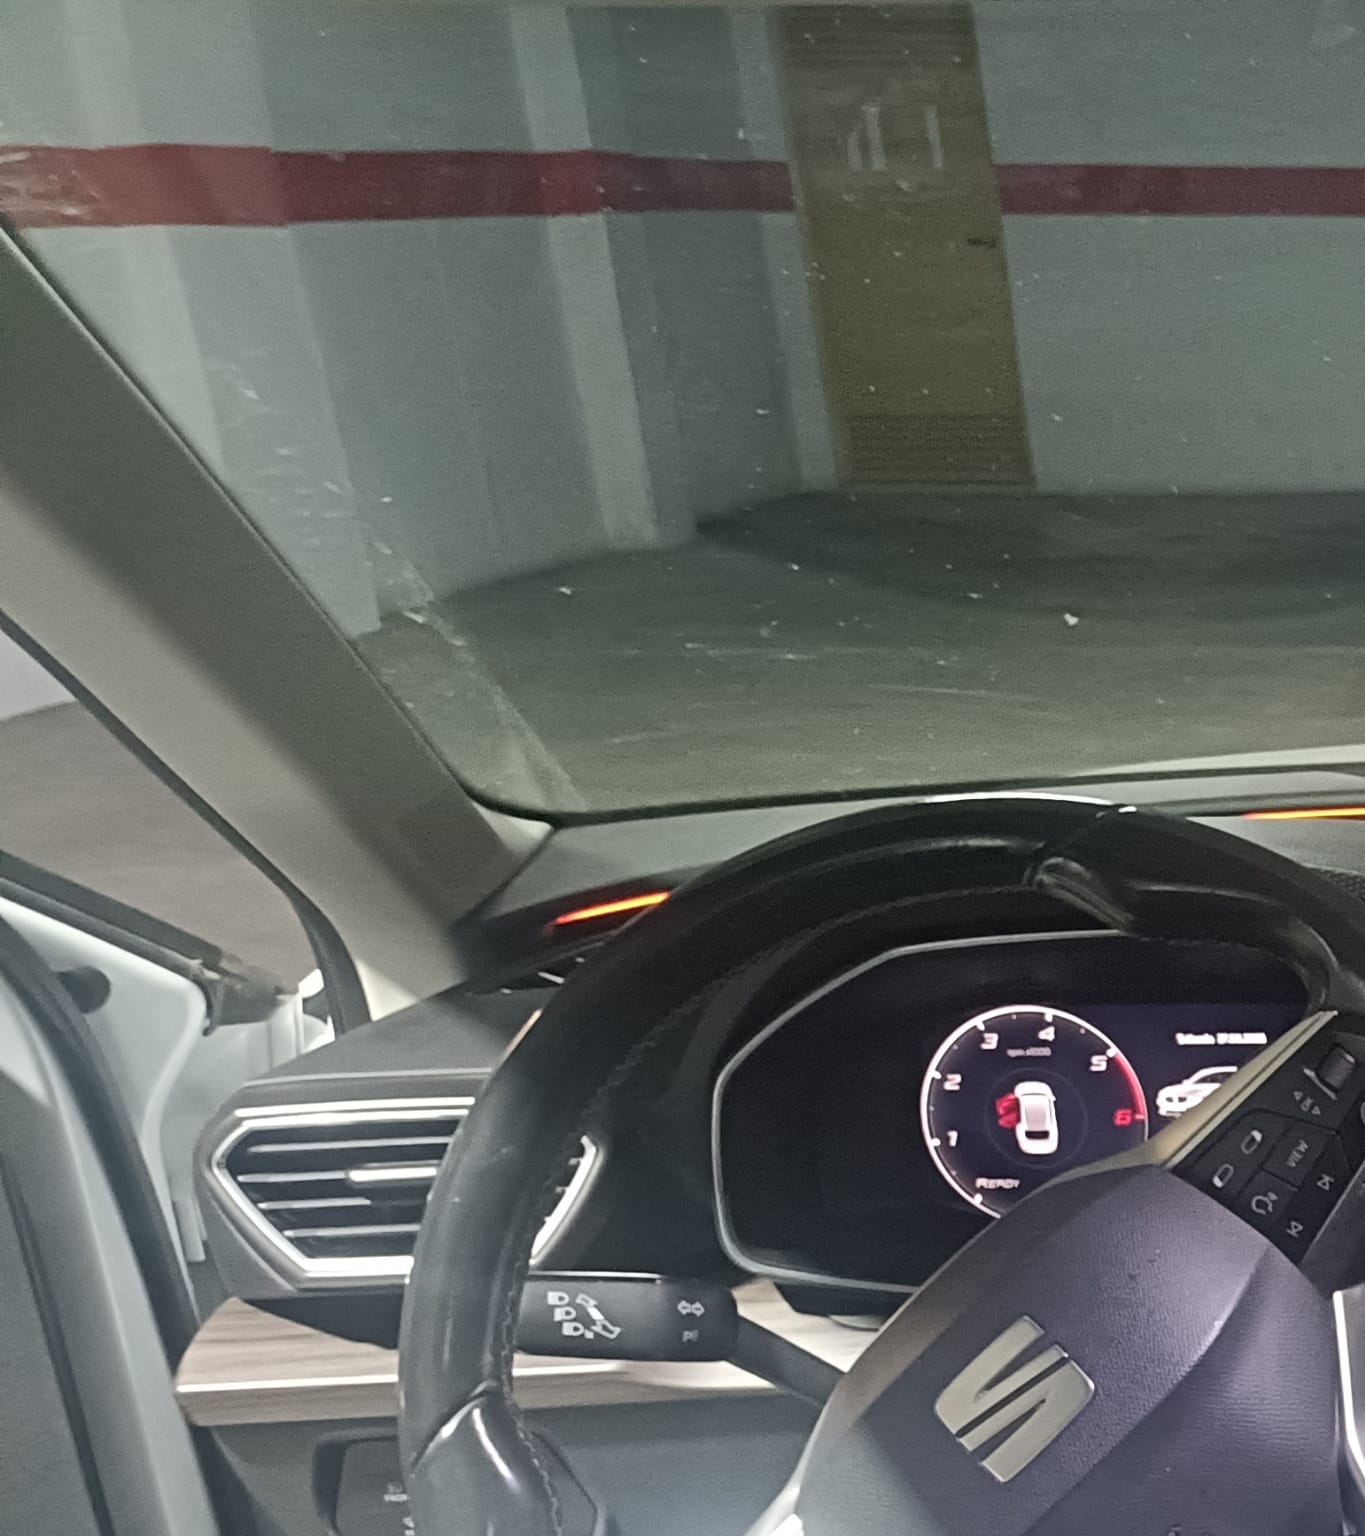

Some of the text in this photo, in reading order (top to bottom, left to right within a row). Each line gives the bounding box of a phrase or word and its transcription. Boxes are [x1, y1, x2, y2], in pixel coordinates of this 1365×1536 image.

[980, 1032, 999, 1050] 3
[1038, 1026, 1055, 1042] 4
[1090, 1055, 1108, 1072] 5
[943, 1073, 962, 1091] 2
[1113, 1109, 1132, 1126] 6
[947, 1130, 958, 1147] 1
[1286, 1139, 1309, 1168] VIEW
